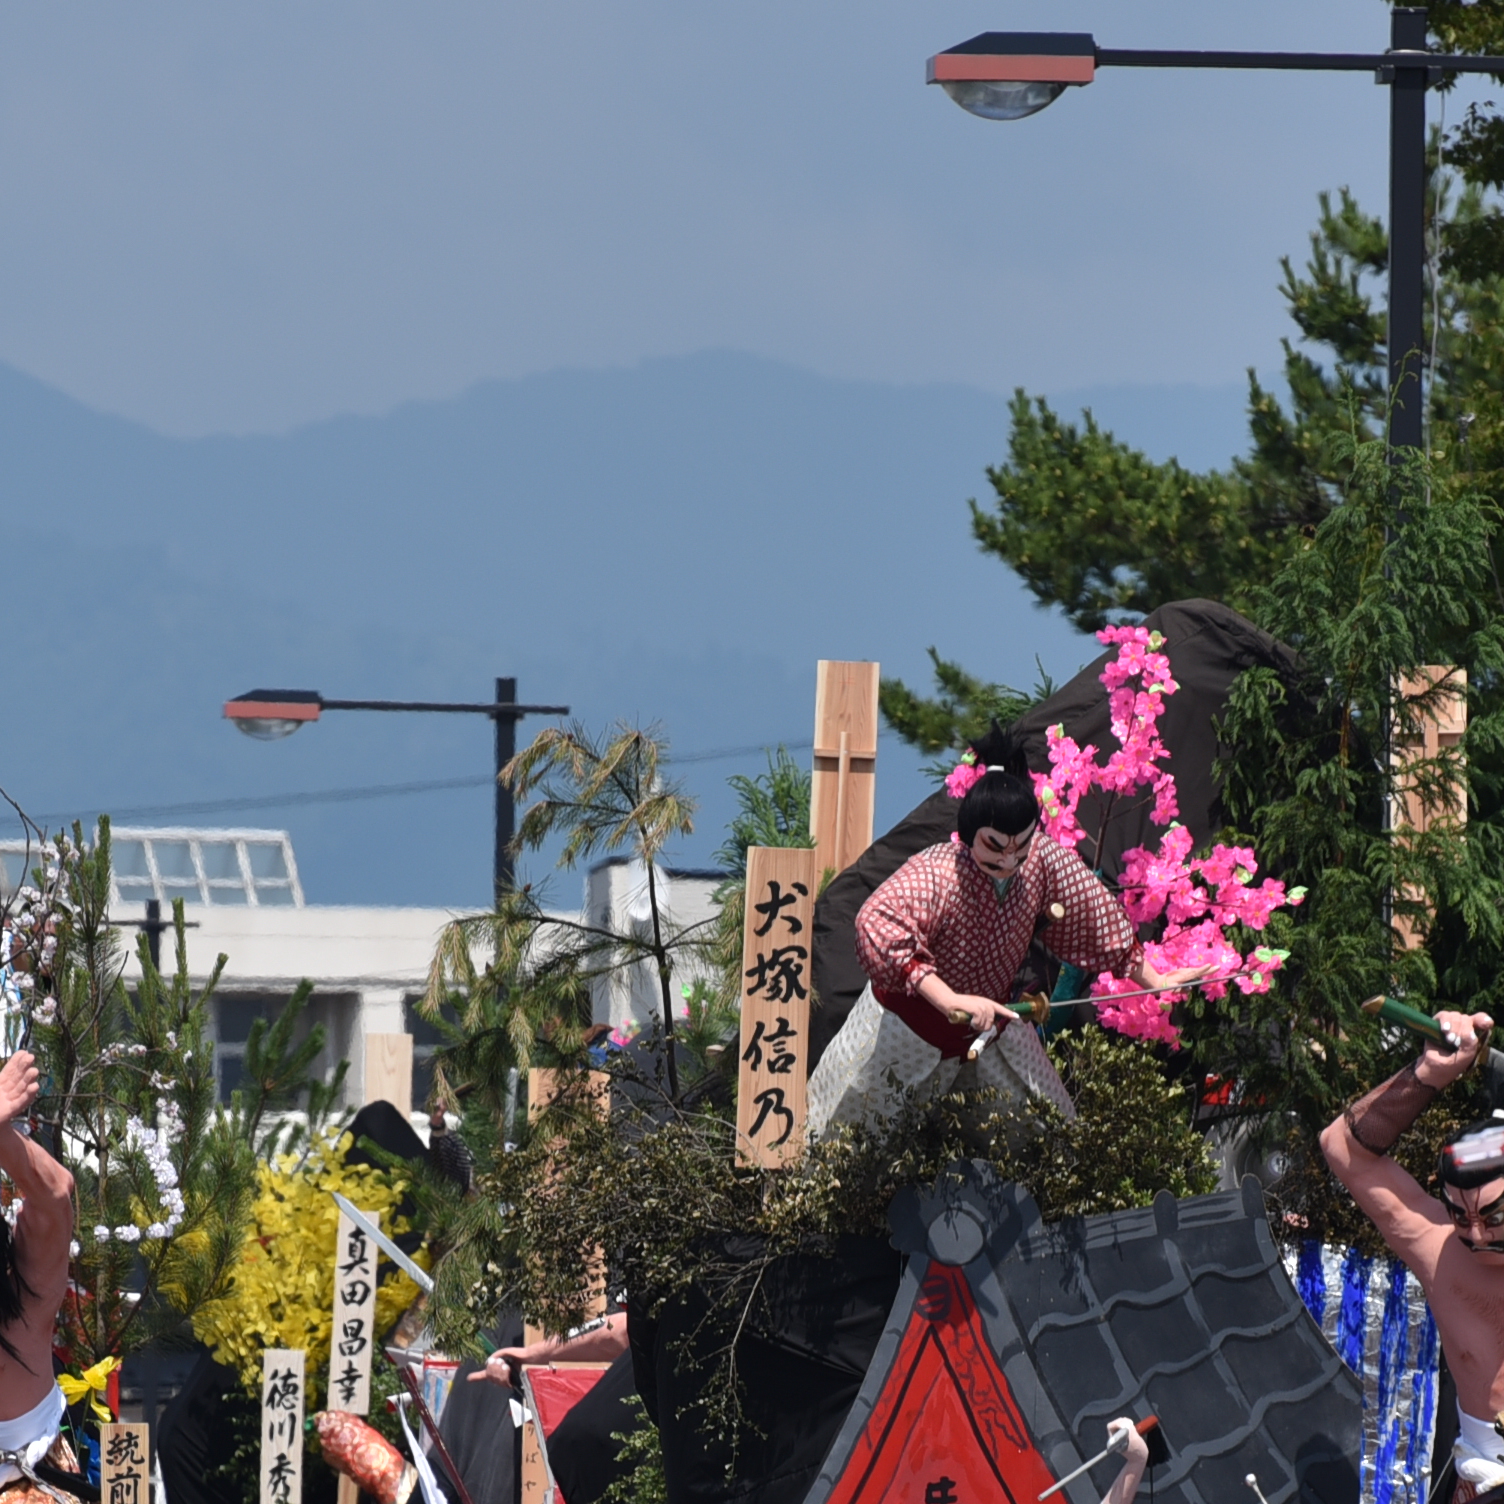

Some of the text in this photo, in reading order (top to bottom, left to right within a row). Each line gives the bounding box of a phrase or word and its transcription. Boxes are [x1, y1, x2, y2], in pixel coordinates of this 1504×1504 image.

[743, 880, 807, 1146] 犬塚信乃
[333, 1228, 372, 1403] 真田昌幸
